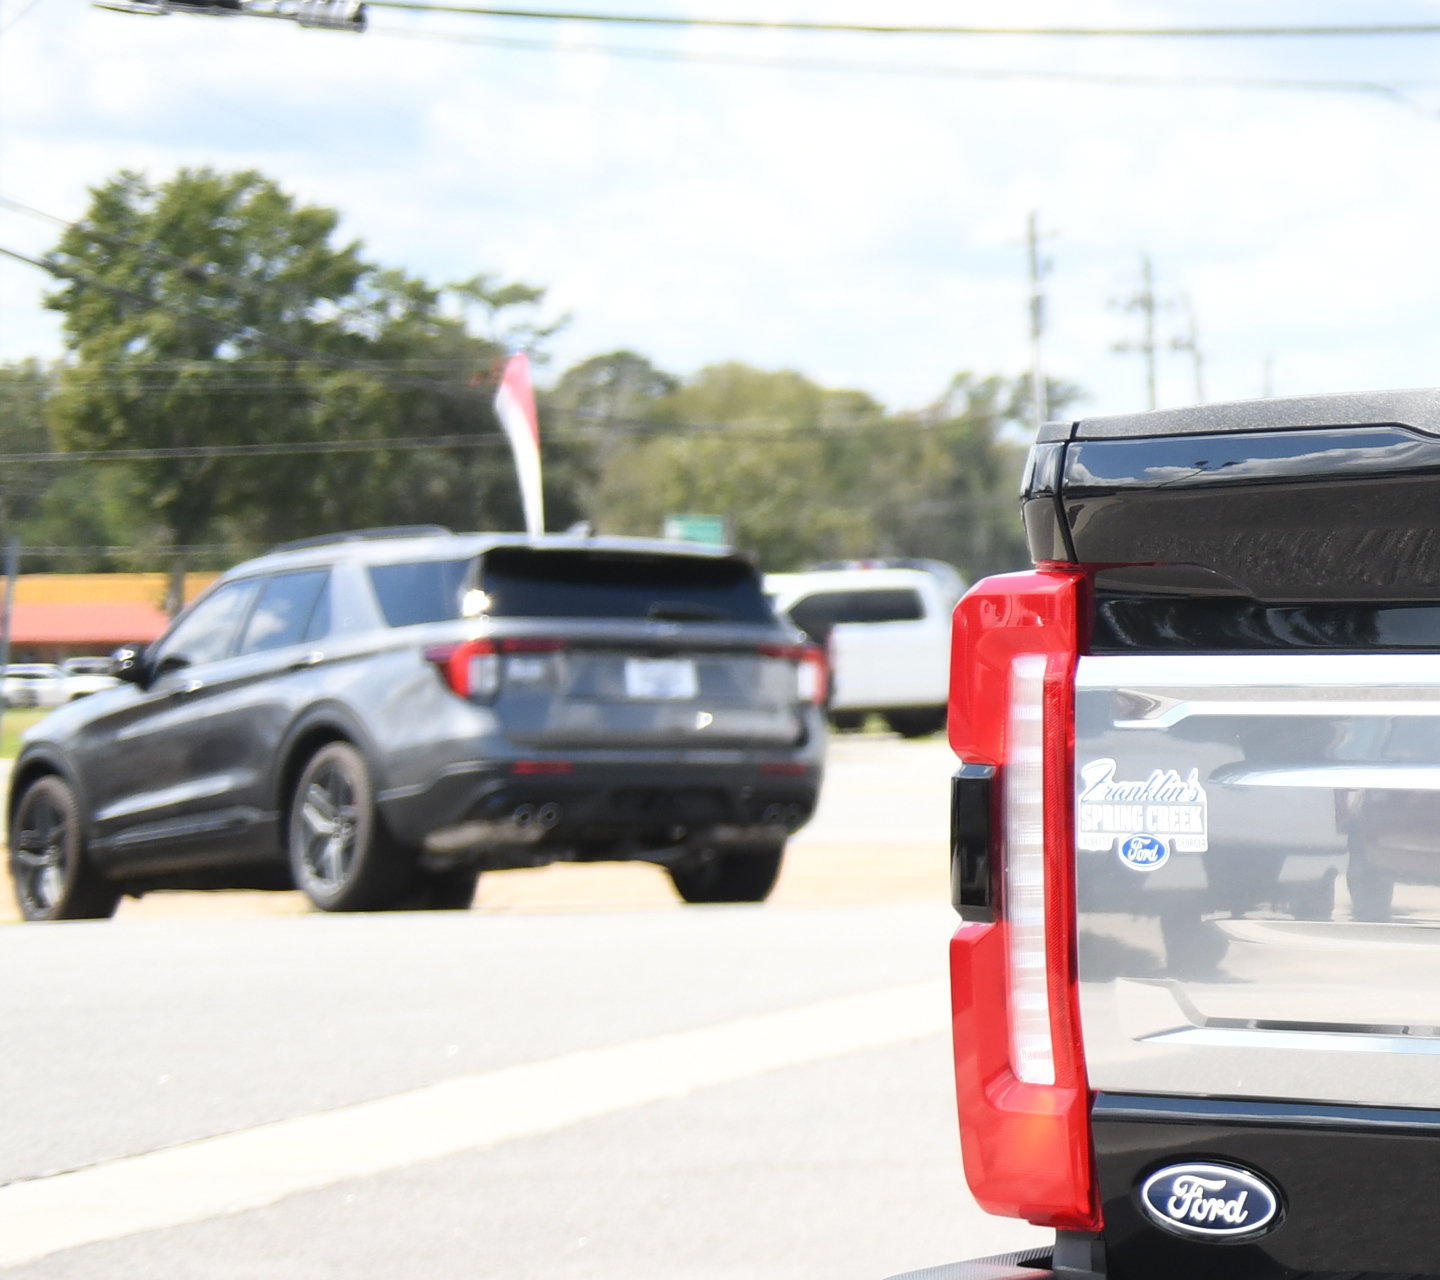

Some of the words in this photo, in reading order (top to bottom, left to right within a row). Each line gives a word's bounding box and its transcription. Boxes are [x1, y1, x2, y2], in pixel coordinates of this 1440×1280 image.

[1080, 760, 1201, 802] Franklin's
[1081, 804, 1144, 832] SPRING
[1146, 805, 1203, 833] CREEK
[1127, 837, 1159, 862] Ford
[1168, 1174, 1249, 1224] Ford
